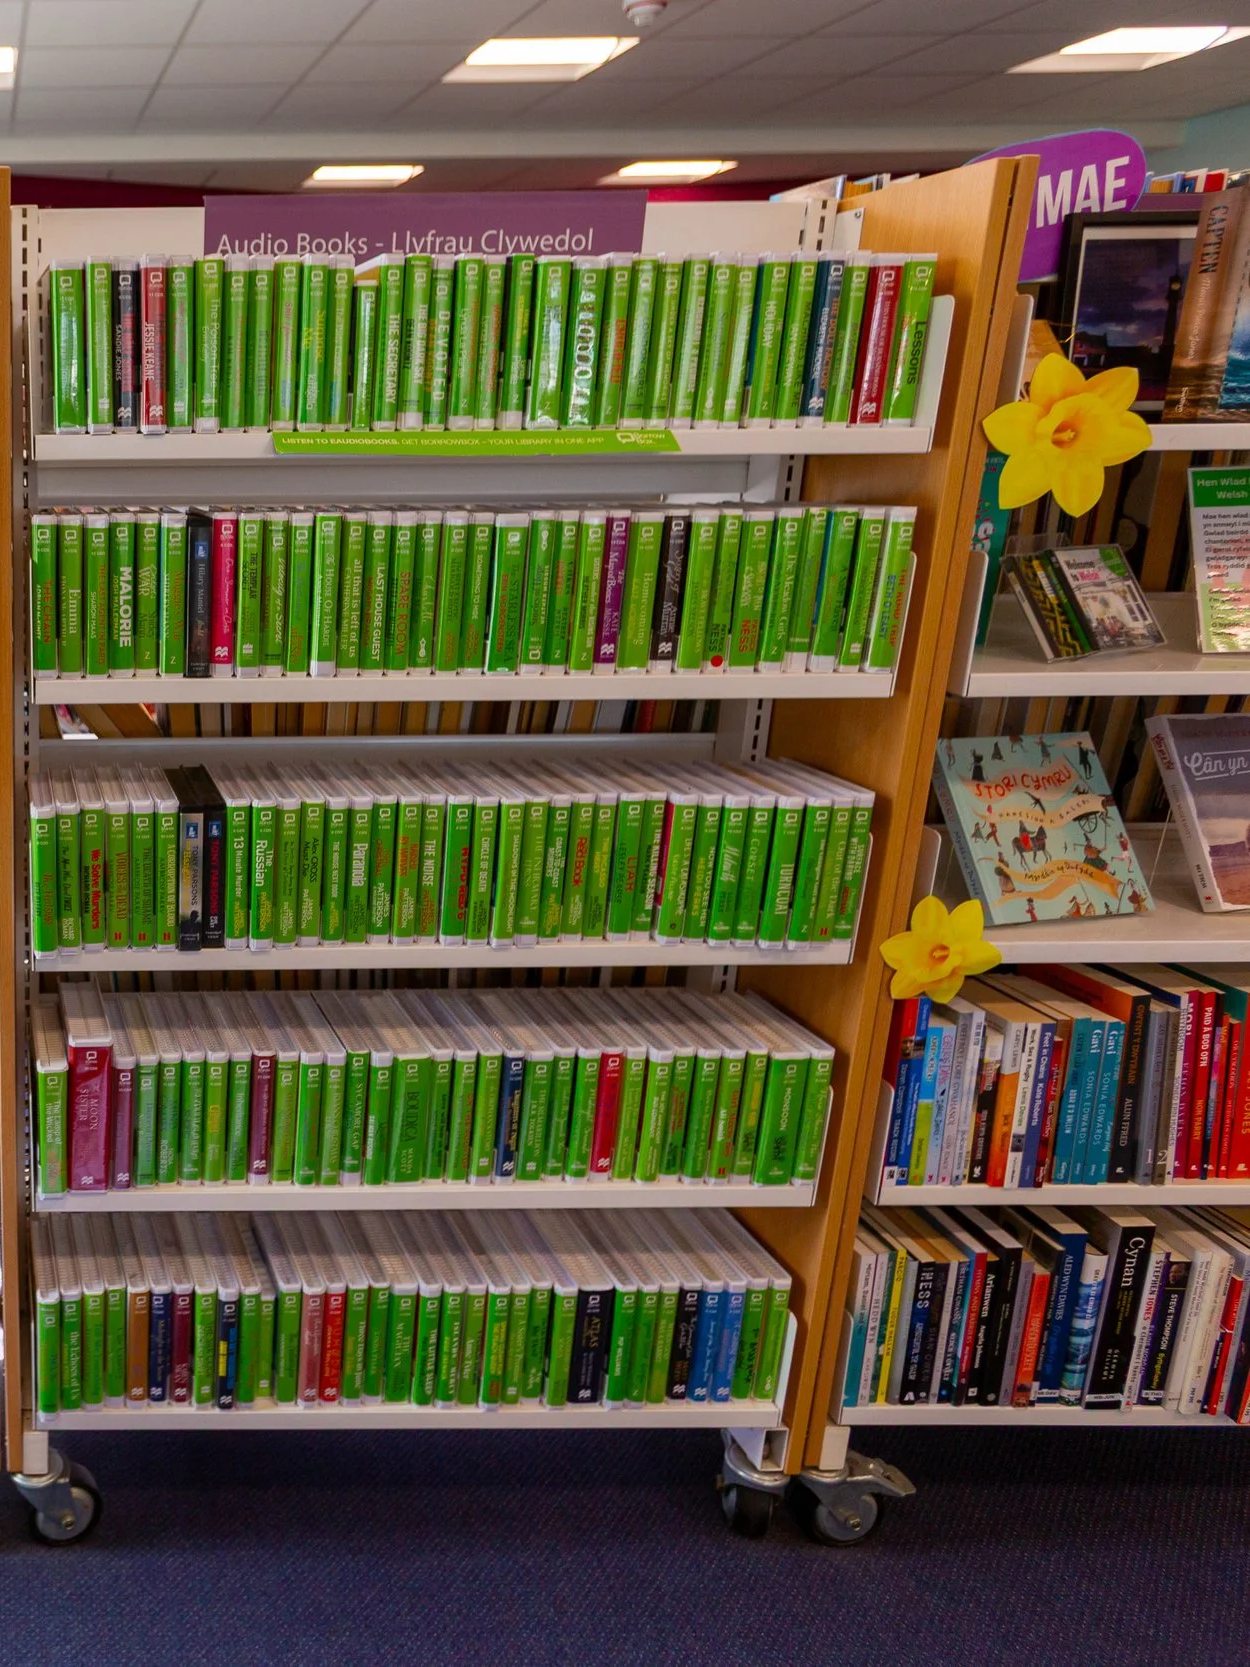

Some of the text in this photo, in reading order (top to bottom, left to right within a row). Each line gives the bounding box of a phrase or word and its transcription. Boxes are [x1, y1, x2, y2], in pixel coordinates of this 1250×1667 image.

[1036, 156, 1130, 229] MAE
[217, 228, 594, 255] Audio Books Llyfrau Clywedol
[1197, 204, 1230, 275] CAPTEN
[762, 301, 778, 348] HOLIDAY
[143, 322, 155, 381] JESSIE KEANE
[385, 313, 400, 404] THE SECRETARY
[907, 321, 927, 385] Lessons
[282, 437, 313, 445] LISTEN
[401, 438, 419, 446] GET
[421, 438, 480, 446] BORROWBOX
[488, 438, 514, 446] YOUR
[516, 438, 552, 446] LIBRARY
[586, 437, 604, 445] APP
[1196, 477, 1246, 487] Hen Wlad
[1216, 490, 1249, 500] Welsh
[67, 589, 81, 634] Emma
[119, 567, 132, 648] MALORIE
[196, 563, 207, 614] Hilary Mantel
[636, 572, 654, 645] Homecoming
[371, 566, 385, 661] LAST HOUSE GUEST
[395, 571, 412, 656] SPARE ROOM
[974, 765, 1073, 800] STORI CYMRU
[233, 836, 245, 849] 13
[255, 840, 269, 888] Russian
[352, 844, 368, 888] Paranoia
[422, 840, 437, 887] THE NOISE
[91, 849, 102, 930] We Solve Murders
[190, 845, 199, 906] TONY PARSONS
[625, 857, 639, 893] LIAR
[773, 864, 795, 916] TURNCOAT
[1203, 1006, 1213, 1025] PAID
[1042, 1032, 1052, 1047] Feet
[1199, 1052, 1209, 1067] OFN
[1200, 1034, 1210, 1049] BOD
[1036, 1083, 1045, 1099] Kate
[1038, 1057, 1049, 1079] Chains
[1077, 1029, 1104, 1145] Gavi SONIA EDWARDS
[1093, 1030, 1120, 1146] Gavi SONIA EDWARDS
[404, 1091, 420, 1143] BOUDICA
[779, 1087, 793, 1132] MONSOON
[1031, 1101, 1043, 1127] Roberts
[1118, 1098, 1134, 1147] ALUN FFRED
[1193, 1117, 1203, 1141] PARRY
[1196, 1100, 1204, 1115] NON
[1120, 1236, 1146, 1288] Cynan
[981, 1273, 996, 1318] Arianwen
[1055, 1254, 1074, 1321] ALED WYN DAVIES
[1143, 1259, 1163, 1321] STEPHEN JONES
[1159, 1294, 1178, 1350] STEVE THOMPSON
